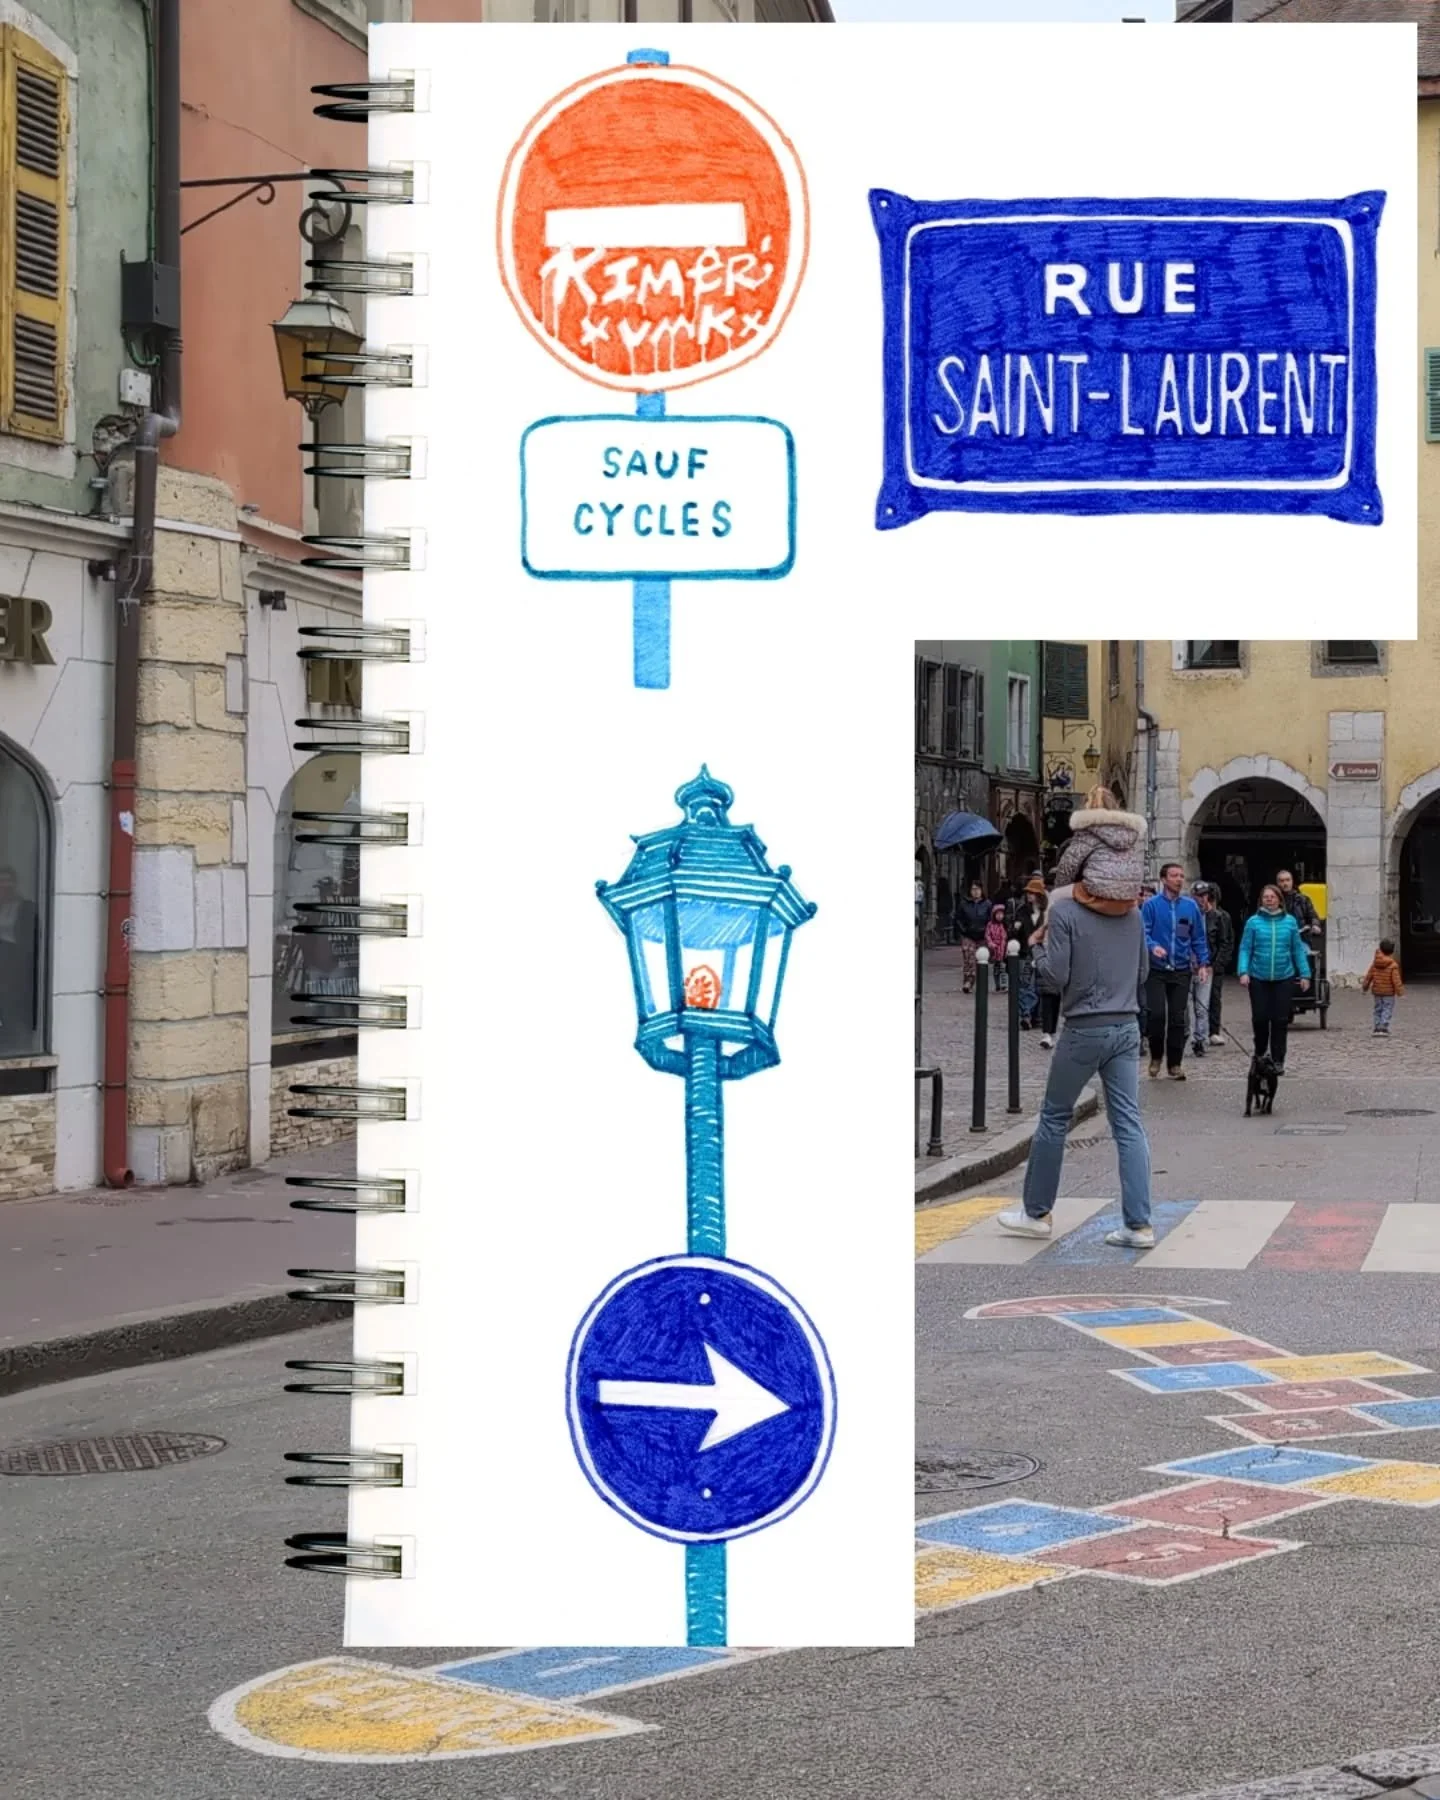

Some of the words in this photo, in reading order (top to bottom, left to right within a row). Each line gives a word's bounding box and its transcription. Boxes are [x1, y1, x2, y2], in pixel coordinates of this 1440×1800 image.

[1044, 261, 1198, 317] RUE
[933, 352, 1347, 438] SAINT-LAURENT
[602, 446, 709, 479] SAUF
[573, 500, 732, 538] CYCLES
